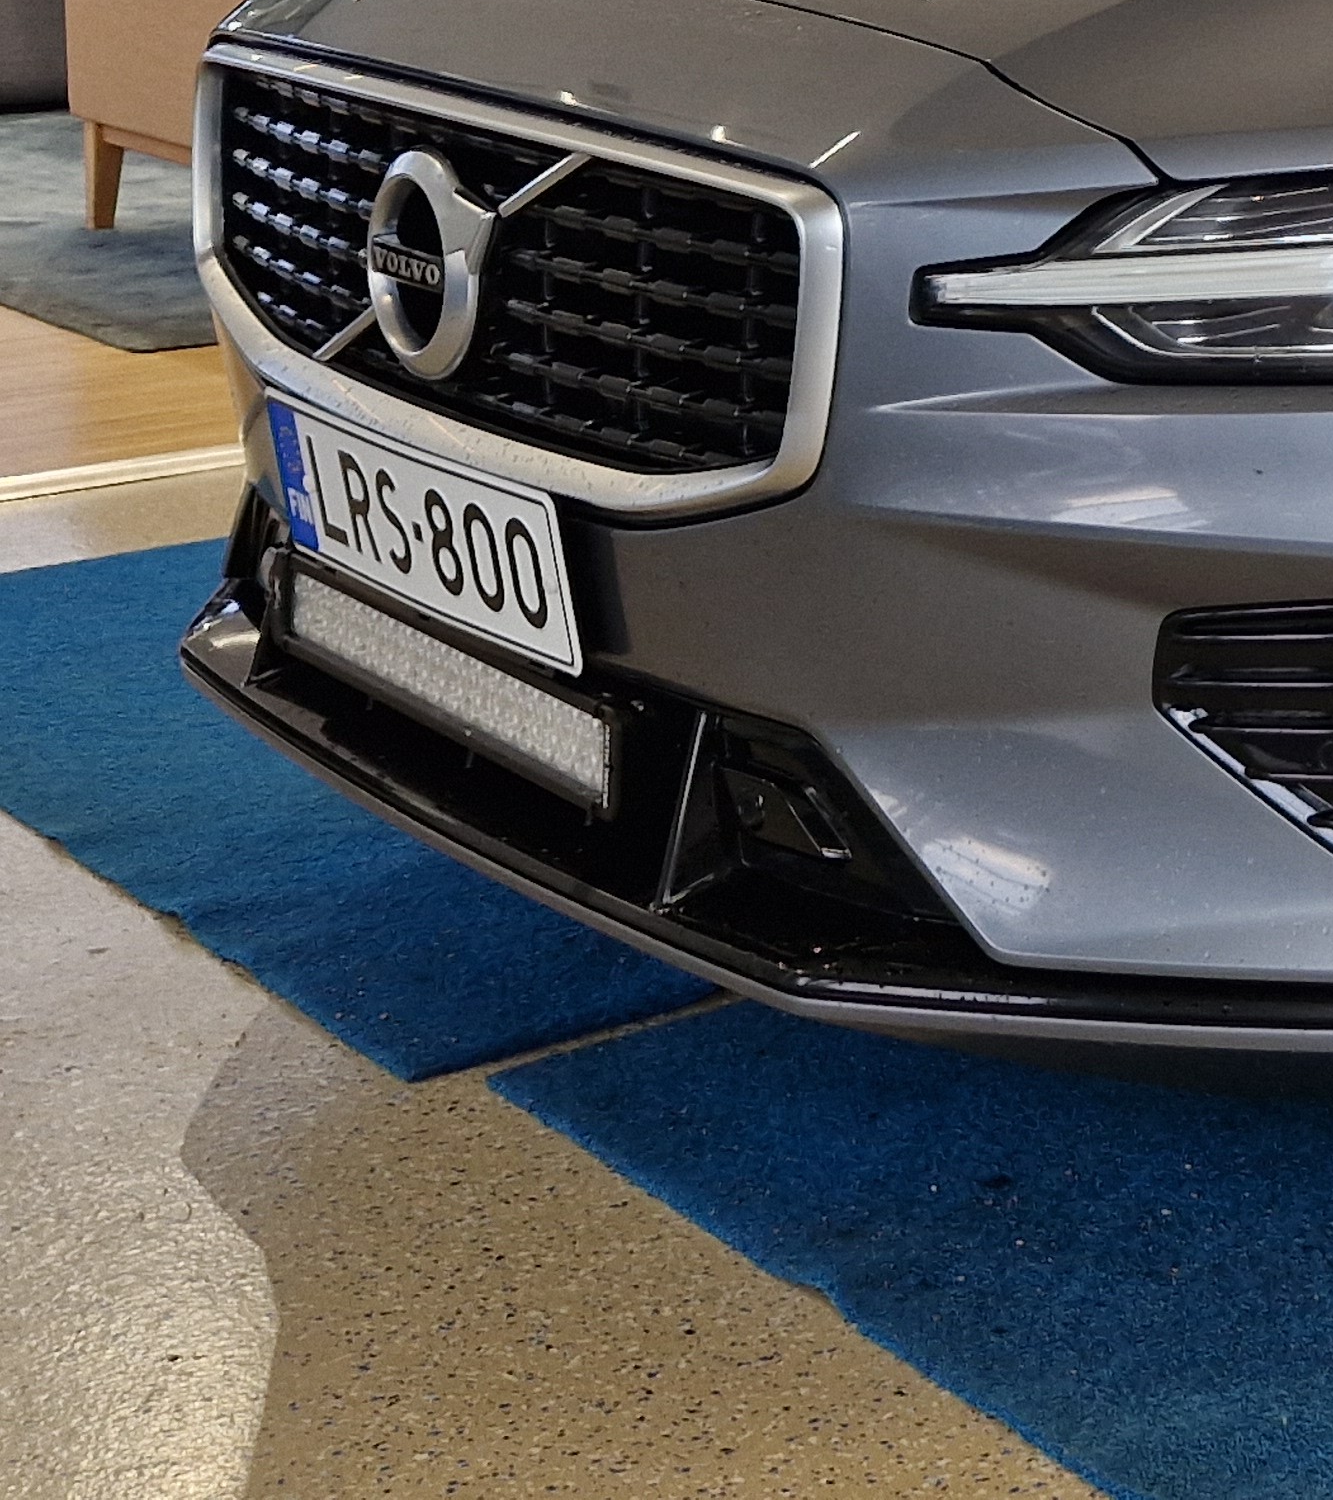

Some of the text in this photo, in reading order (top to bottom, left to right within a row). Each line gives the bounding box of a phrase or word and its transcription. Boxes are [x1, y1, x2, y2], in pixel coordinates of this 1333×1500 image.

[373, 245, 440, 285] VOLVO
[286, 486, 316, 526] FIN
[304, 434, 549, 630] LRS-800
